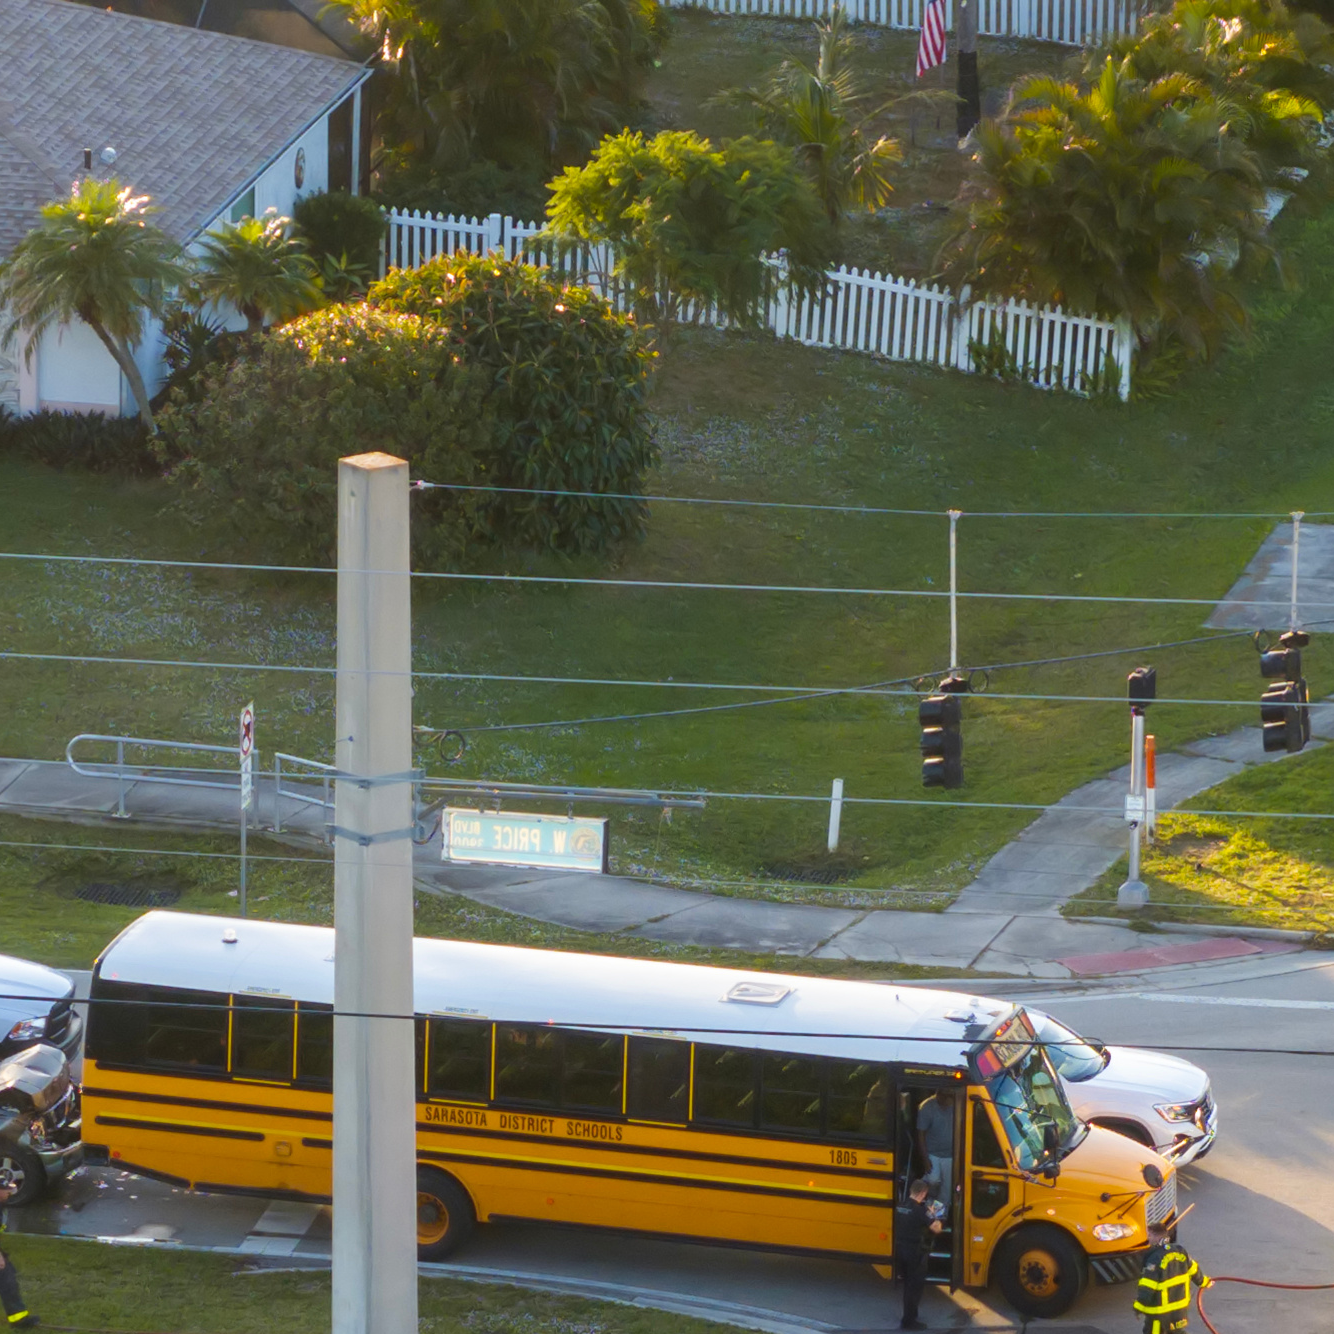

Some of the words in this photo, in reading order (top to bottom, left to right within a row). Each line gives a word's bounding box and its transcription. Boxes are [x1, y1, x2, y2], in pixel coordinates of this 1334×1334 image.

[425, 1106, 488, 1127] SARASOTA
[500, 1114, 555, 1133] DISTRICT
[567, 1121, 623, 1141] SCHOOLS
[829, 1150, 858, 1166] 1805
